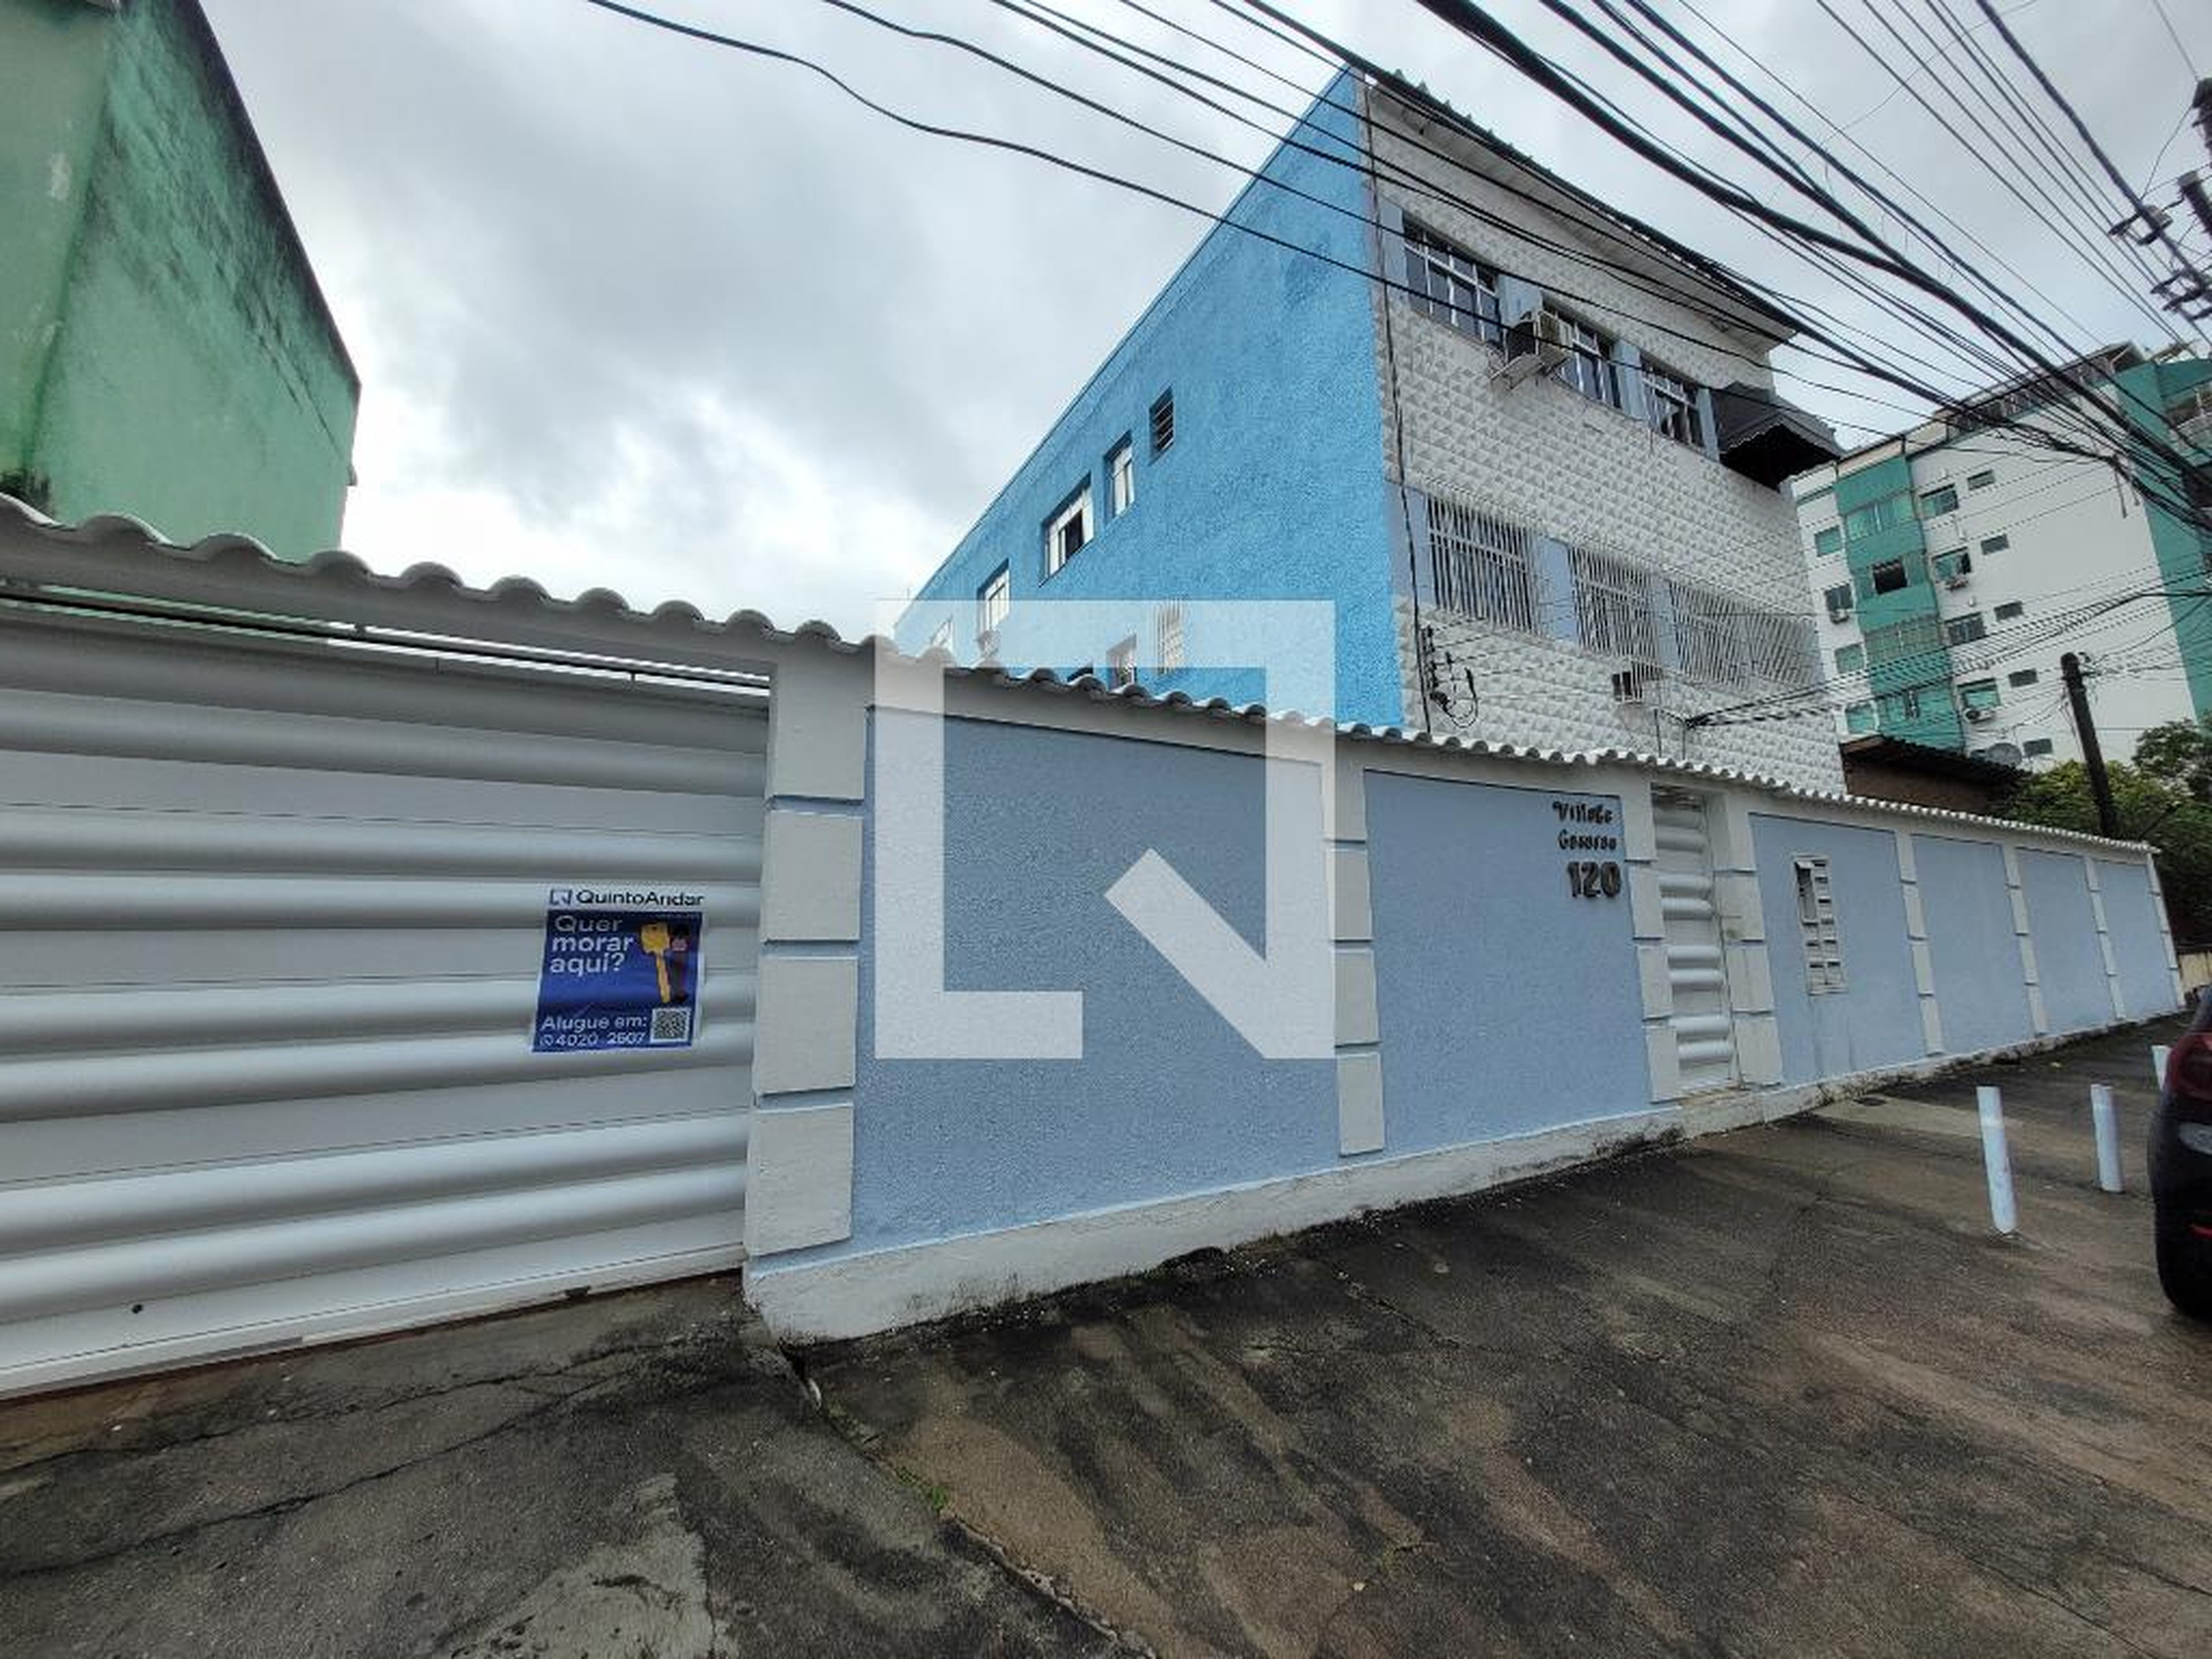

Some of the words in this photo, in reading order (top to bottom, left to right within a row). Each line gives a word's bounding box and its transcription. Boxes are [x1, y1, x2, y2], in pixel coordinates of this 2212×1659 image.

[1568, 862, 1622, 898] 120
[576, 889, 704, 906] QuintoAndar
[555, 915, 623, 934] Quer
[552, 936, 634, 952] morar
[550, 952, 625, 977] aqui?
[540, 1016, 609, 1033] Alugue
[614, 1016, 647, 1029] em:
